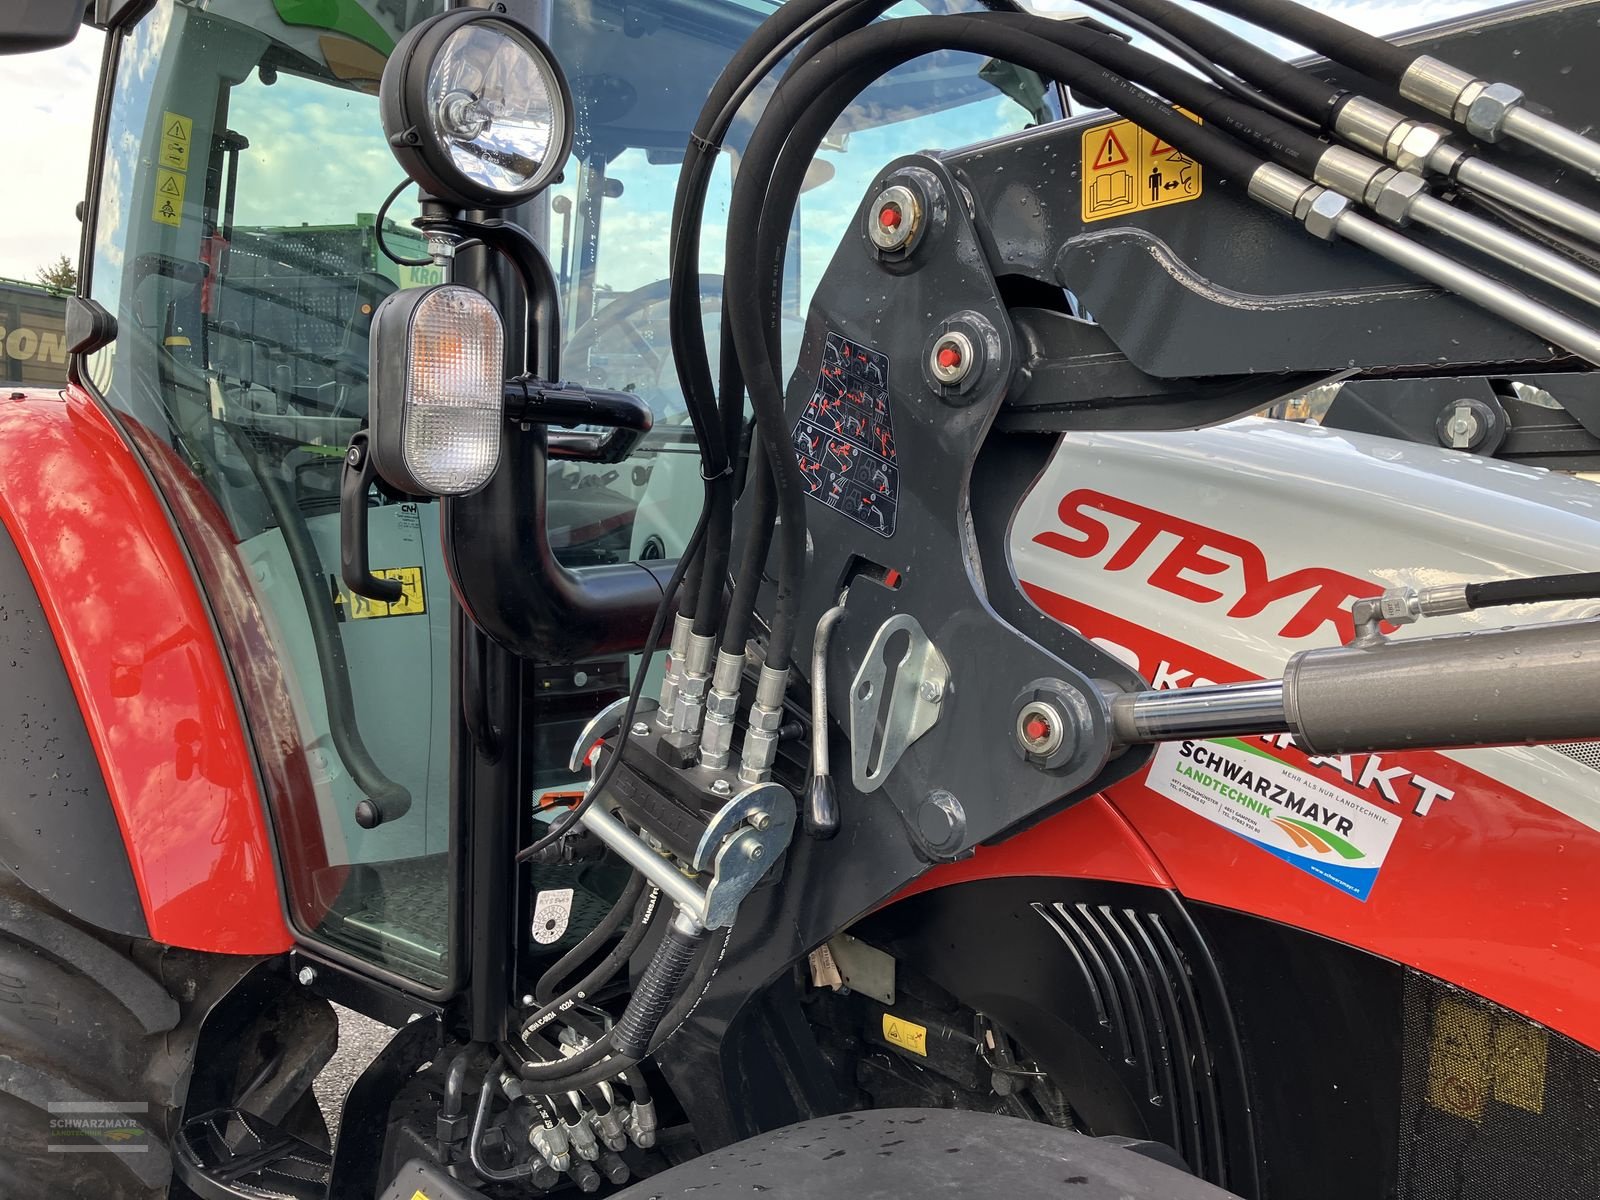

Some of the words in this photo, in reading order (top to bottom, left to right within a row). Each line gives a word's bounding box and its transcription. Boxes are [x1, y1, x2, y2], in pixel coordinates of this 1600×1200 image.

[1032, 488, 1403, 646] STEYR
[1175, 761, 1273, 819] LANDTECHNIK
[1178, 740, 1354, 838] SCHWARZMAYR
[1281, 769, 1302, 784] MEHR
[1303, 780, 1318, 791] ALS
[1318, 787, 1334, 799] NUR
